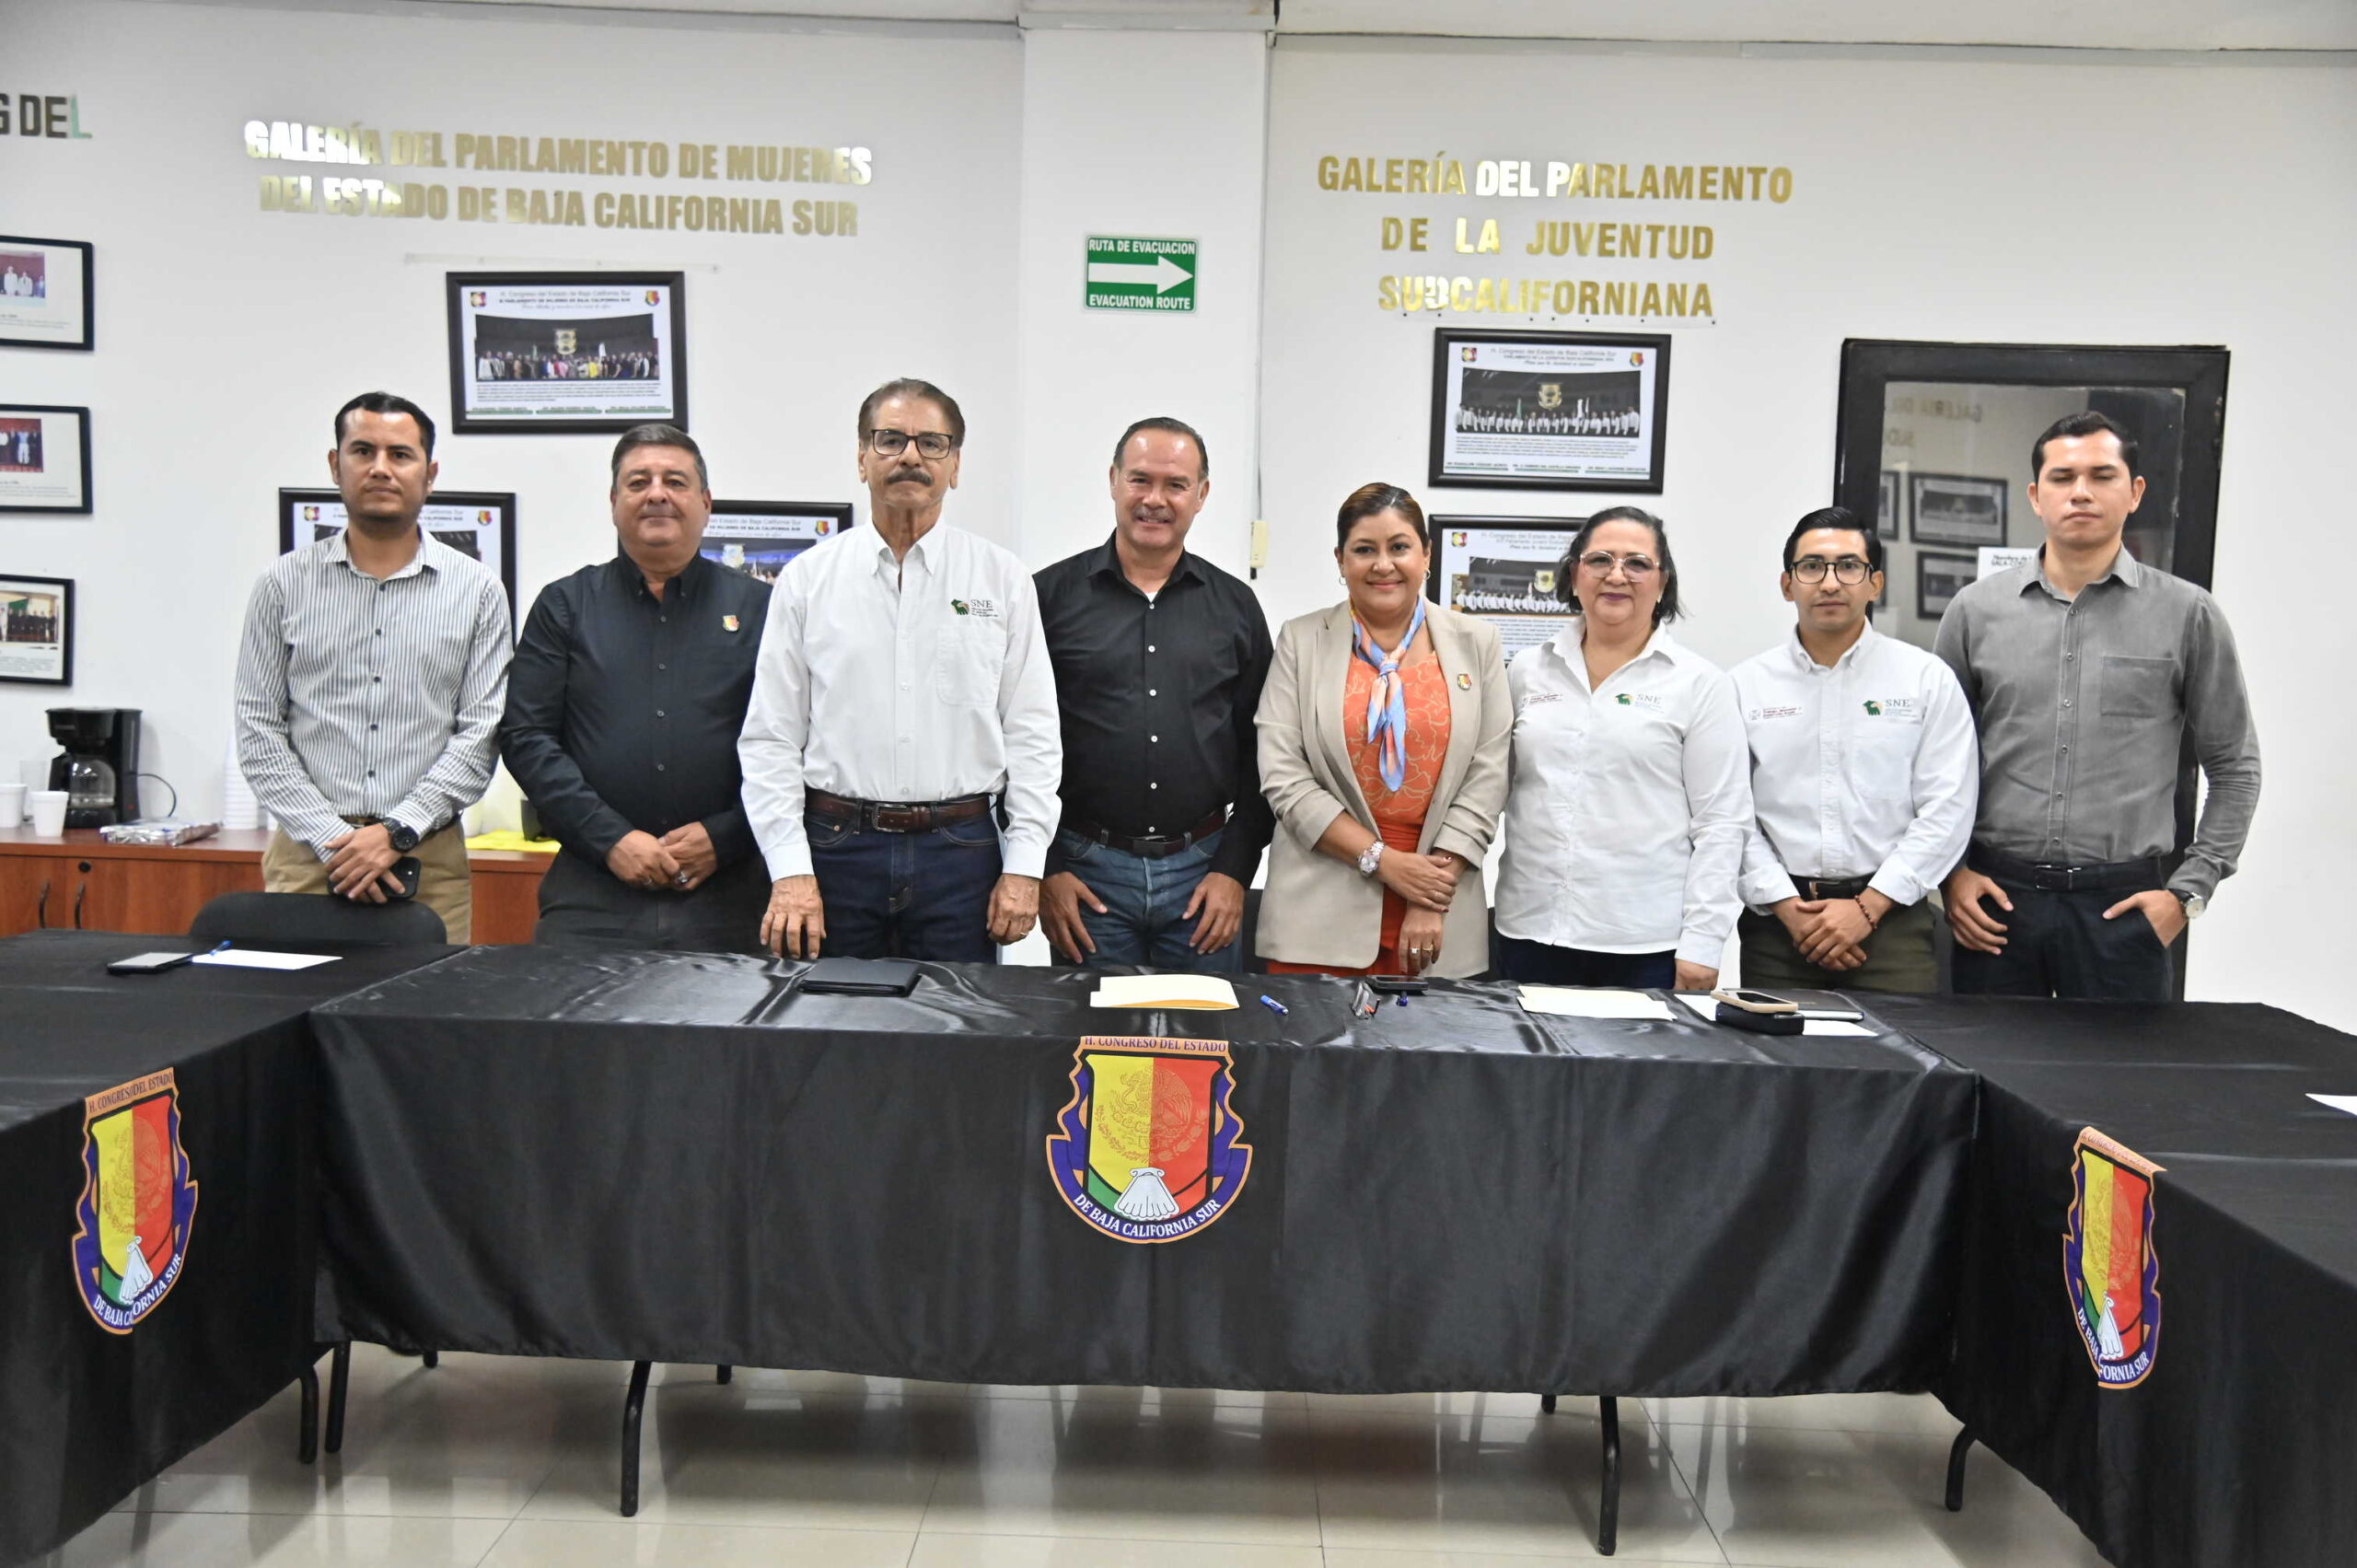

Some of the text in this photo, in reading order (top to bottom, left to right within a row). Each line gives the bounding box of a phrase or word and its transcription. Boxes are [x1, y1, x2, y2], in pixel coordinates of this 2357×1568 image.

[19, 94, 93, 139] DEL
[244, 121, 872, 185] GALERÍA DEL PARLAMENTO DE MUJERES
[1318, 150, 1793, 203] GALERÍA DEL PARLAMENTO
[260, 175, 857, 237] DEL ESTADO DE BAJA CALIFORNIA SUR
[1089, 239, 1195, 254] RUTA DE EVACUACION
[1382, 217, 1714, 260] DE LA JUVENTUD
[1089, 295, 1190, 309] EVACUATION ROUTE
[1378, 275, 1713, 317] SUDCALIFORNIANA
[970, 599, 993, 609] SNE
[1886, 699, 1910, 707] SNE
[1085, 1037, 1226, 1052] H. CONGRESO DEL ESTADO
[98, 1086, 134, 1110] CONGRESO
[134, 1081, 147, 1096] DEL
[148, 1072, 173, 1090] ESTADO
[1074, 1193, 1223, 1237] DE BAJA CALIFORNIA SUR
[94, 1294, 107, 1316] DE
[104, 1306, 123, 1326] BAJA
[166, 1253, 182, 1283] SUR
[2077, 1307, 2088, 1330] DE
[2084, 1327, 2099, 1361] BAJA
[2134, 1351, 2150, 1376] SUR
